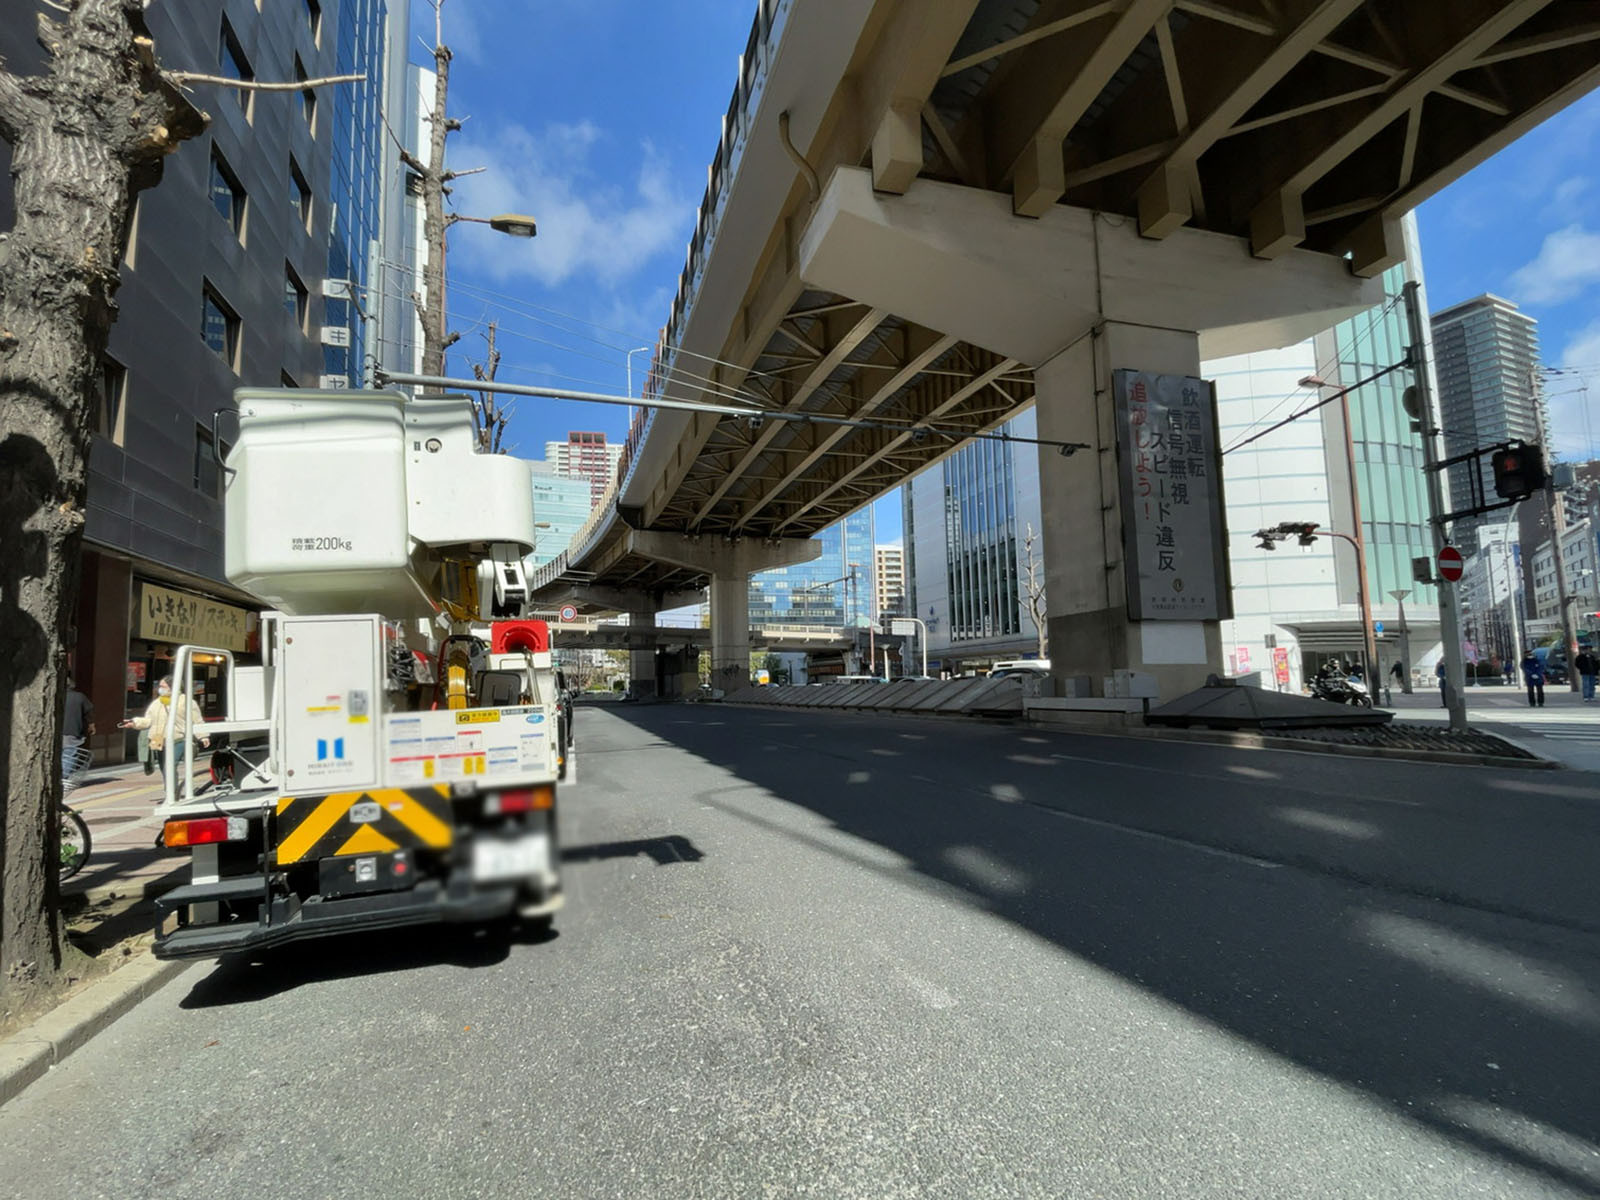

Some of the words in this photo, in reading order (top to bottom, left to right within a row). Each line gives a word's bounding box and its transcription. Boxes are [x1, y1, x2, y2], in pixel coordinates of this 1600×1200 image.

[1129, 381, 1153, 521] 追放しよう！
[1166, 408, 1190, 505] 信号無視
[1182, 387, 1206, 478] 飲酒運転
[1150, 432, 1176, 572] スピード違反
